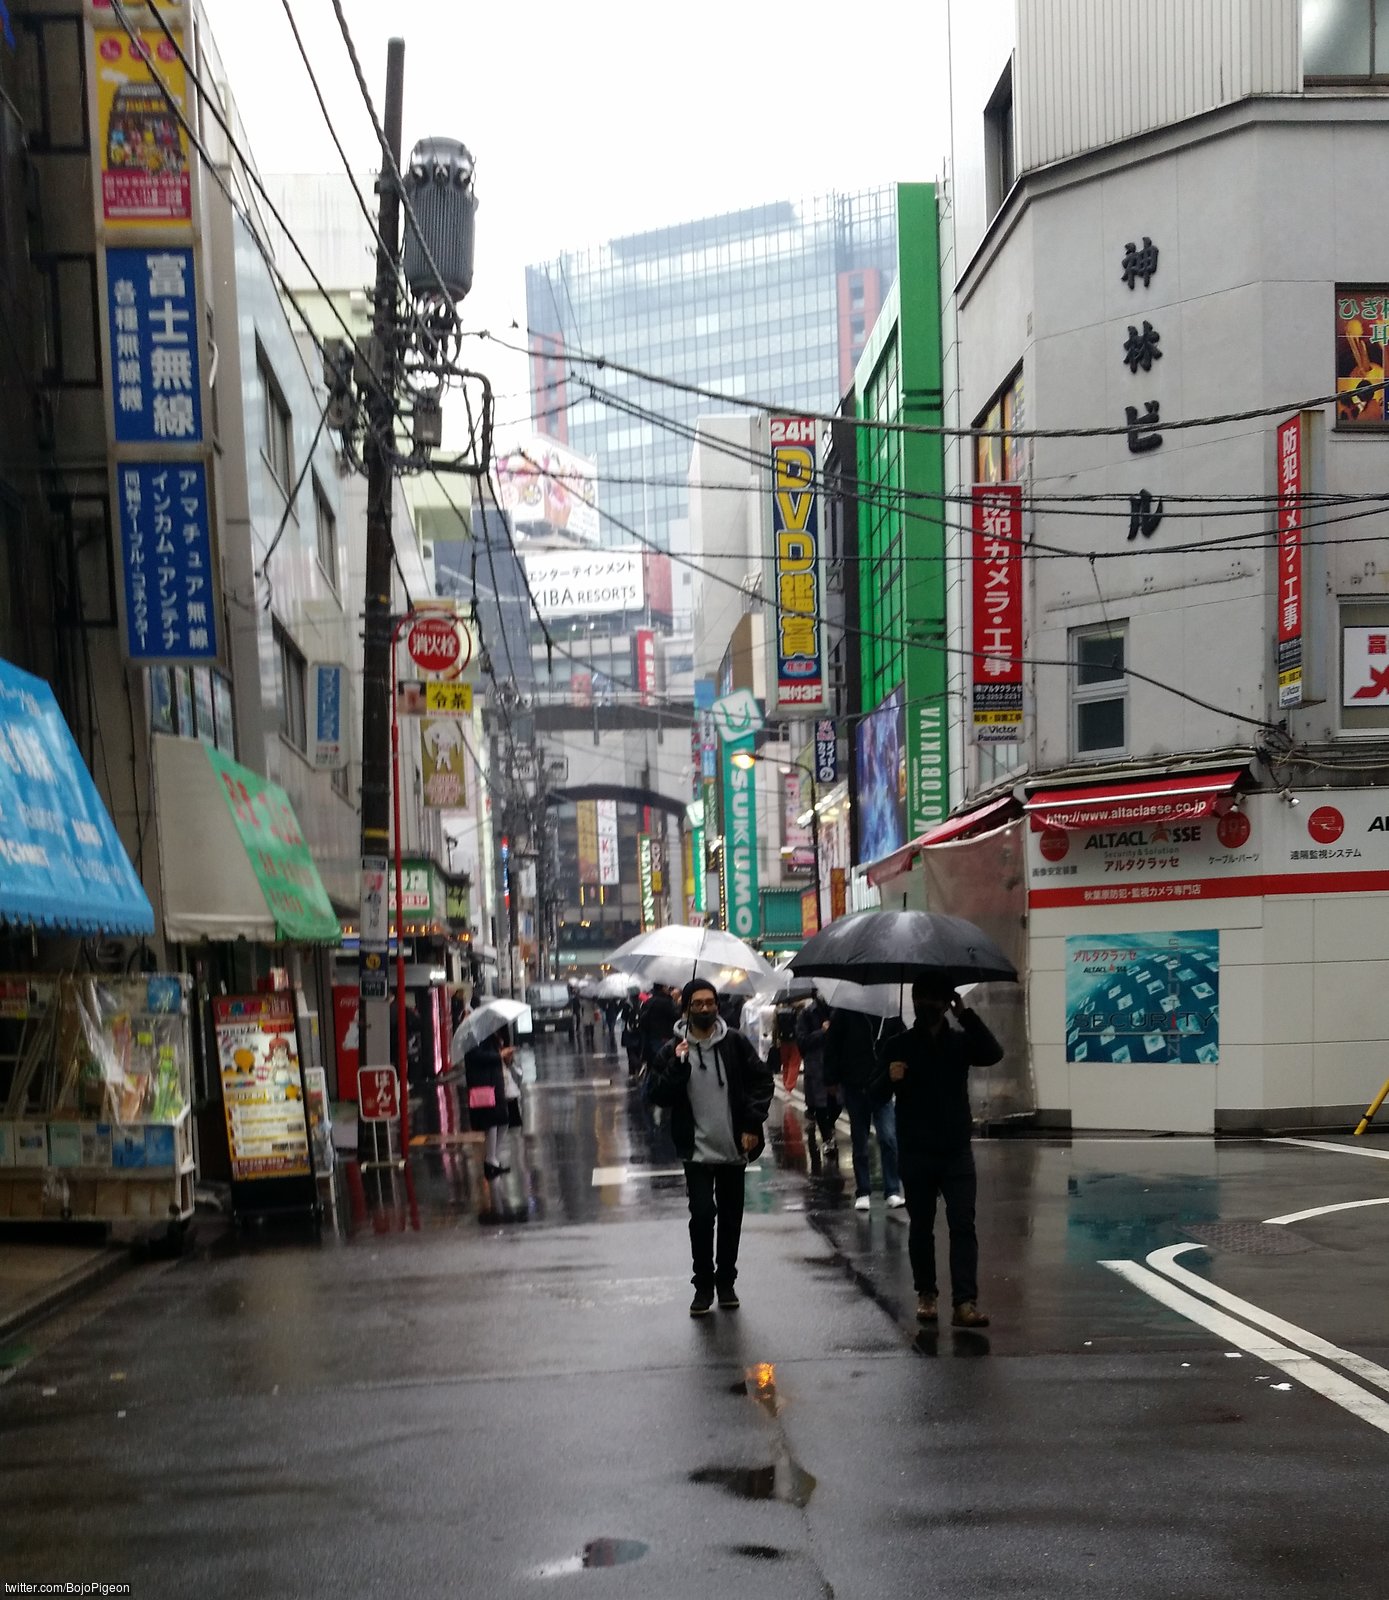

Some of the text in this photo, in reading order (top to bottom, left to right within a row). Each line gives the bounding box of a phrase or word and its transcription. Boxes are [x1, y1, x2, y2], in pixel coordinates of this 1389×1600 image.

[147, 253, 194, 437] 富士無線
[1121, 237, 1163, 540] 神林ビル
[771, 421, 815, 442] 24H
[179, 470, 209, 649] アマチュア無線
[577, 585, 637, 605] RESORTS
[412, 633, 457, 657] 消火栓
[914, 707, 942, 832] KOTOBUKIYA
[1046, 799, 1206, 825] http://www.altaclasse.co.jp
[1104, 855, 1180, 873] アルタクラッセ
[1290, 848, 1362, 860] 遠隔監視システム
[1073, 949, 1137, 963] アルタクラッセ
